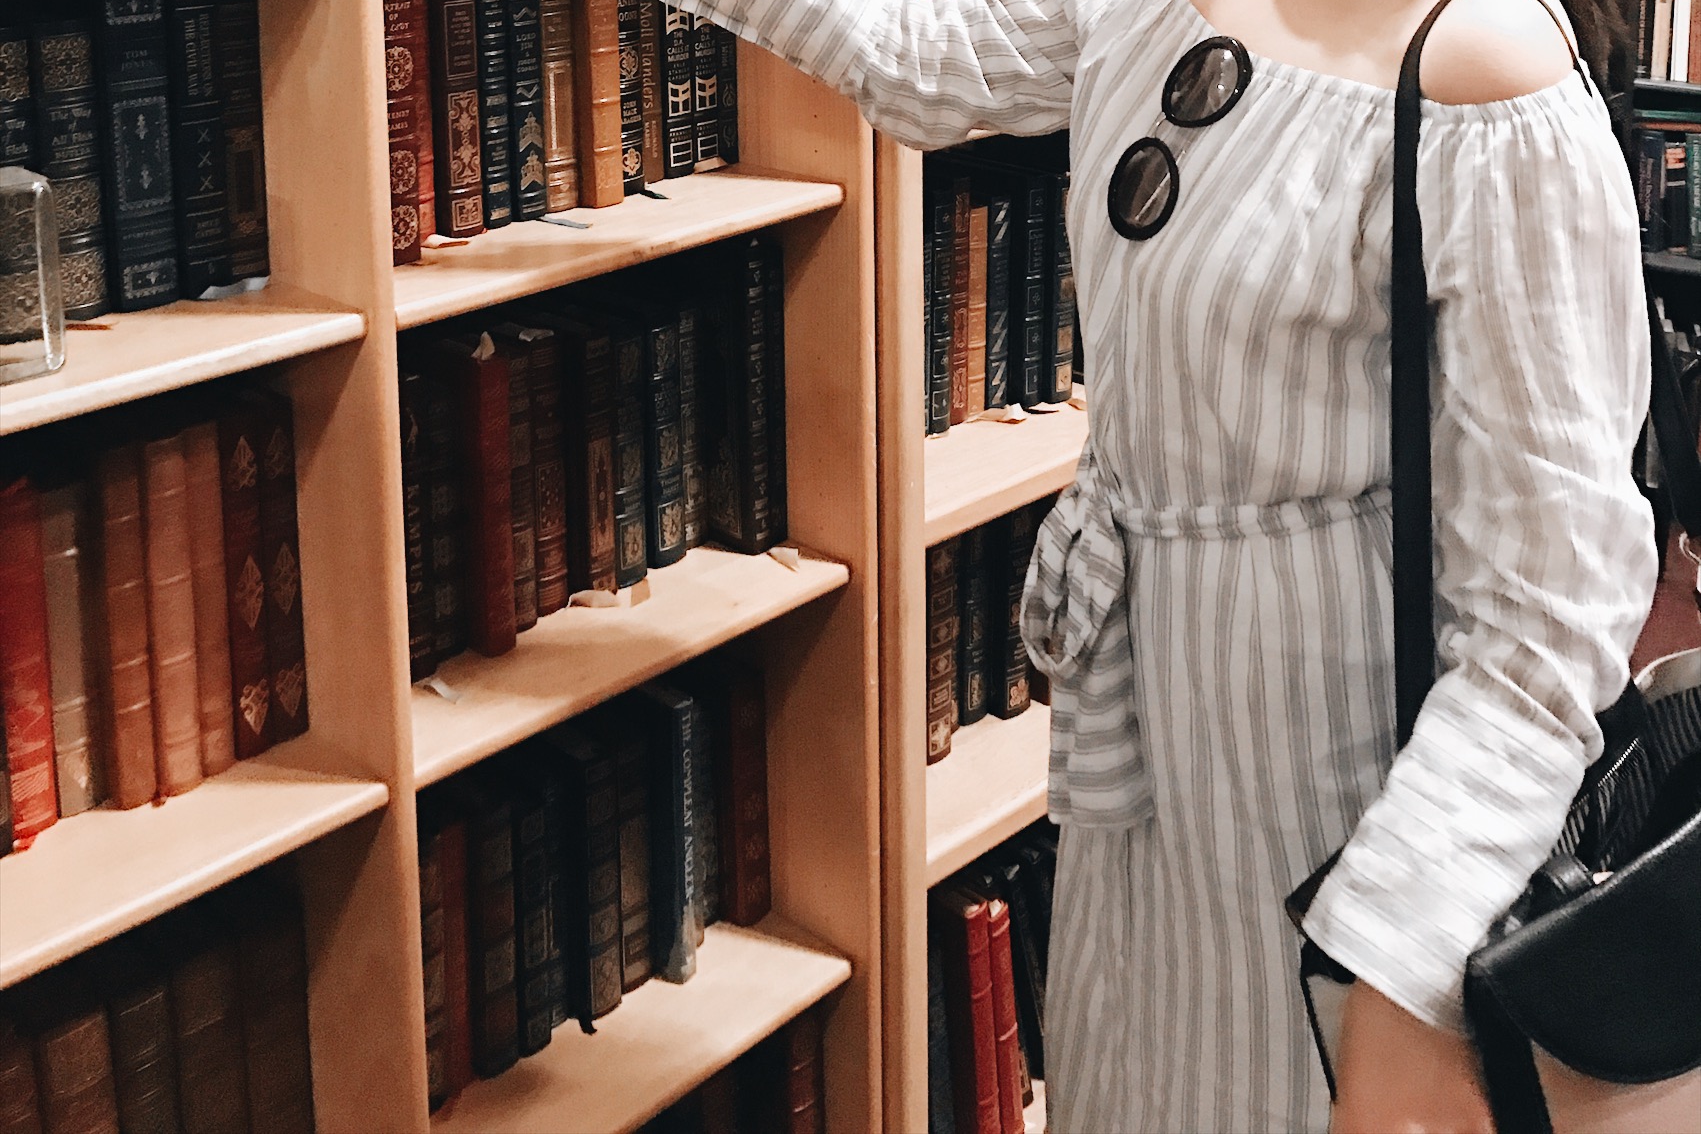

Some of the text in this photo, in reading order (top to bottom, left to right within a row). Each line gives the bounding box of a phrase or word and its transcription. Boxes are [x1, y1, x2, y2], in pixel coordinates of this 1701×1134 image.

[384, 1, 411, 12] RTRAIT
[388, 13, 399, 21] OF
[618, 11, 638, 22] OONE
[673, 30, 684, 39] THE
[700, 26, 711, 34] THE
[515, 32, 536, 42] LORD
[666, 44, 685, 55] CALLS
[694, 40, 712, 50] CALLS
[184, 18, 200, 96] THE CIVIL WAR
[639, 2, 657, 109] Moll Flanders
[667, 51, 690, 63] MURDER
[694, 47, 716, 58] MURDER
[407, 483, 423, 595] KAMPUS
[681, 711, 695, 899] THE COMPLEAT ANGLER
